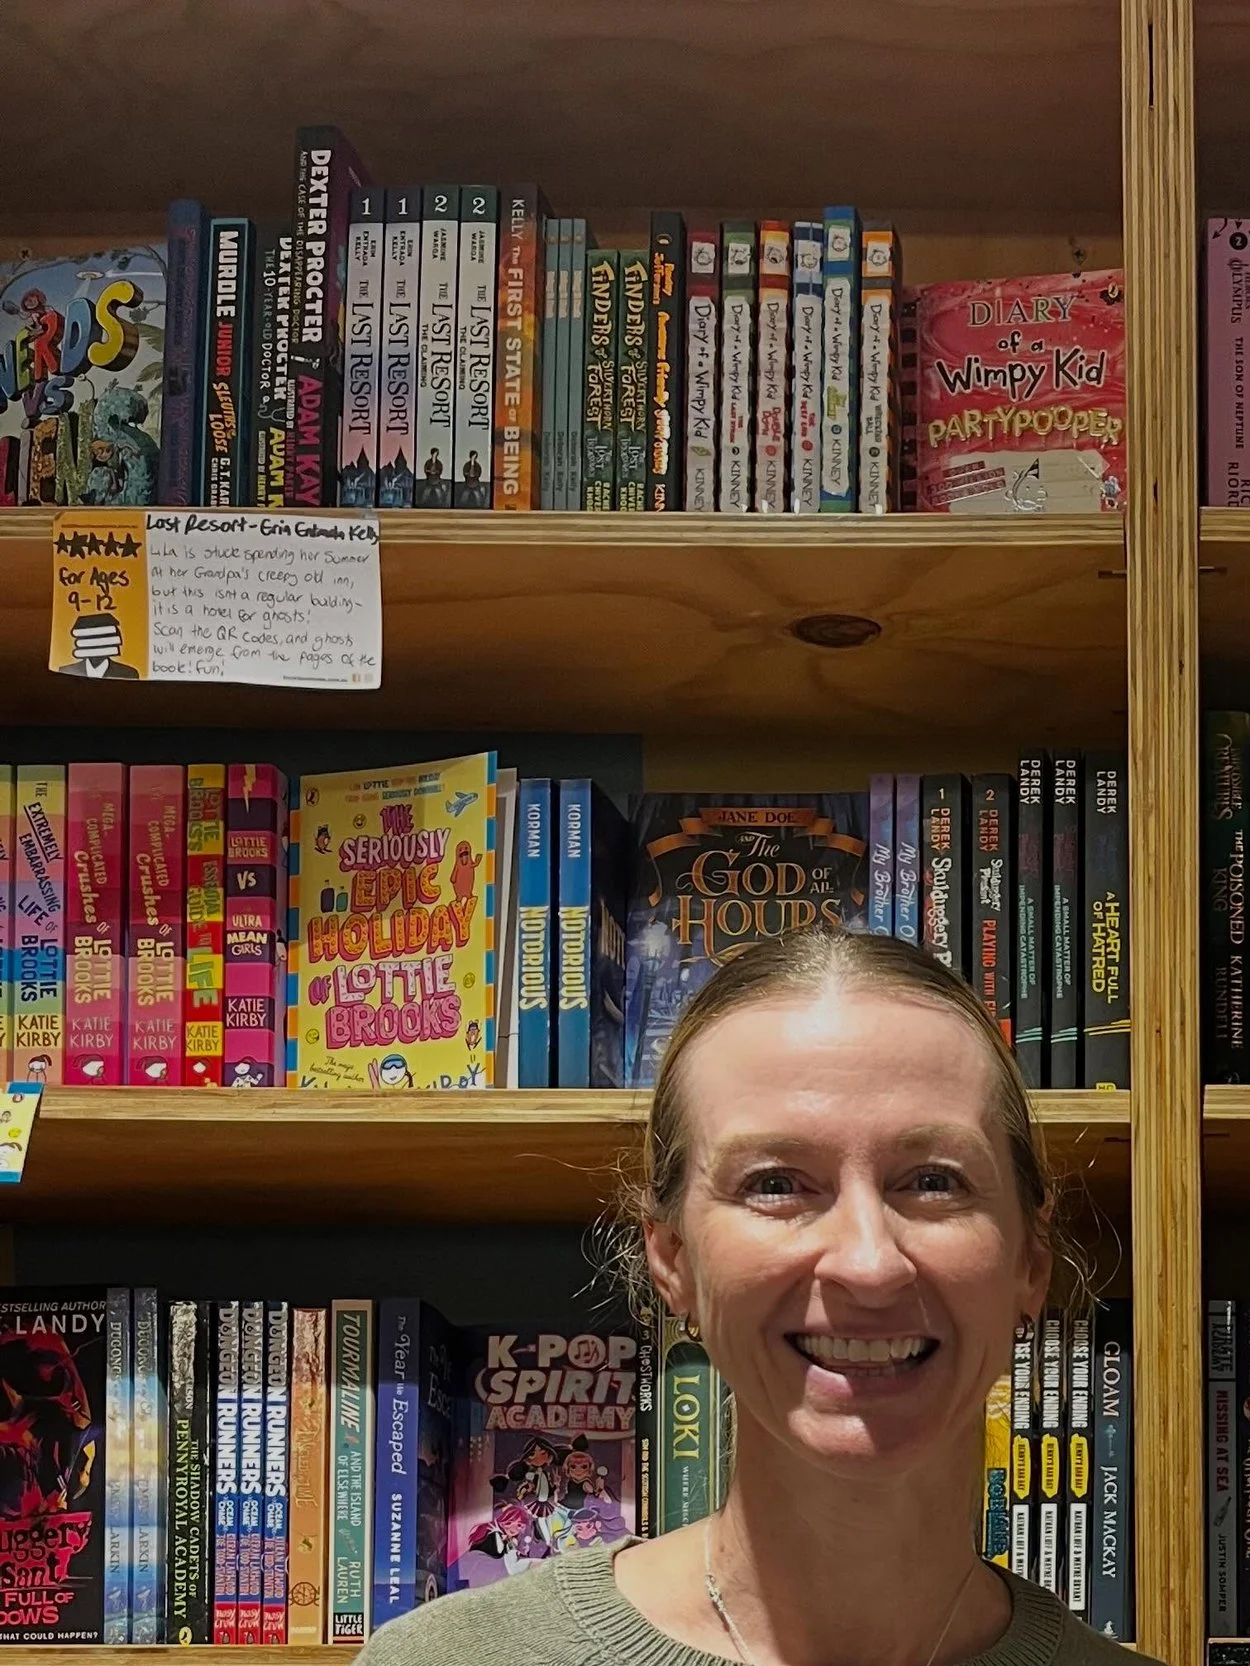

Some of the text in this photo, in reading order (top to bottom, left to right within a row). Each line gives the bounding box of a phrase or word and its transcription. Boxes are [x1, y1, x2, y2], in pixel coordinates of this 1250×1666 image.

[301, 149, 331, 343] DEXTER PROCTER
[213, 230, 239, 390] MURDLE JUNIOR
[969, 296, 1076, 326] DIARY
[388, 279, 412, 437] THE LAST RESORT
[500, 198, 524, 496] KELLY FIRST STATE BEING
[997, 331, 1044, 352] of a
[937, 348, 1106, 398] Wimpy Kid
[928, 406, 1122, 447] PARTYPOOPER
[90, 567, 129, 590] Ages
[68, 592, 115, 611] 9-12
[717, 809, 797, 824] JANE DOE
[338, 828, 451, 872] SERIOUSLY
[351, 866, 442, 912] EPIC
[691, 851, 806, 897] GOD
[520, 804, 548, 1010] KORMAN NOTORIOUS
[308, 896, 478, 964] HOLIDAY
[330, 954, 456, 1007] LOTTIE
[16, 1031, 62, 1047] KIRBY
[17, 1015, 60, 1030] KATIE
[324, 995, 463, 1050] BROOKS
[15, 1313, 107, 1335] LANDY
[337, 1312, 361, 1431] TOURMALINE
[487, 1334, 637, 1368] K-POP
[484, 1369, 637, 1404] SPIRIT
[484, 1405, 637, 1431] ACADEMY
[672, 1375, 700, 1459] LOKI
[1100, 1340, 1121, 1577] GLOAM JACK MACKAY
[334, 1613, 363, 1623] LITTLE
[334, 1623, 363, 1635] TIGER
